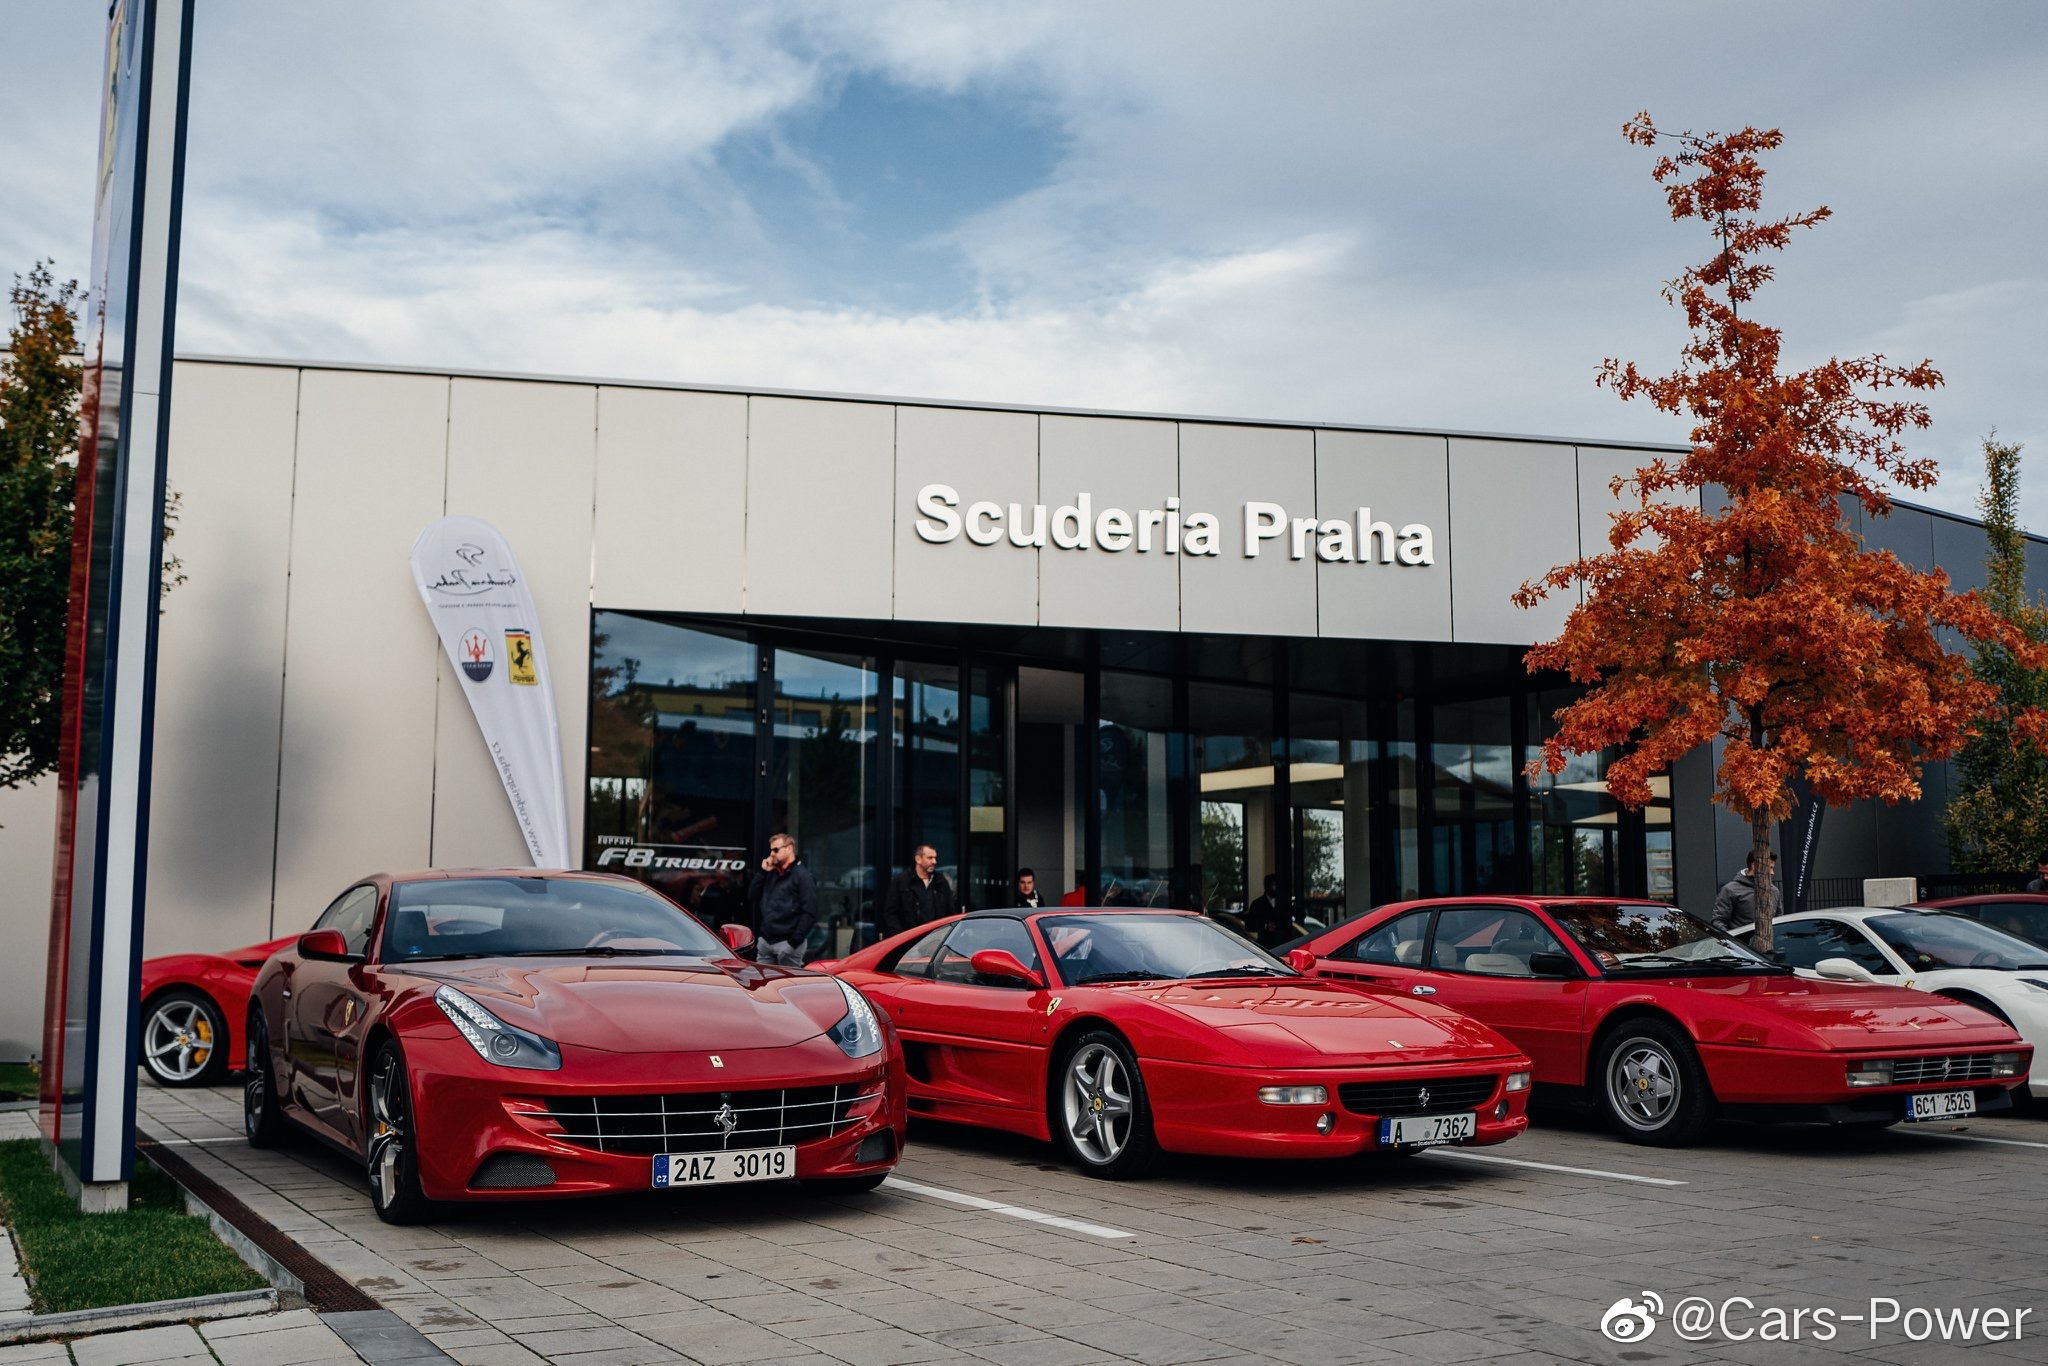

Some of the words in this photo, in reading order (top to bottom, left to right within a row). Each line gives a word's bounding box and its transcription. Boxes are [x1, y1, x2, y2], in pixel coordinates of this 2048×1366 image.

[915, 483, 1220, 555] Scuderia
[1243, 500, 1435, 566] Praha
[597, 835, 634, 846] Ferrari
[597, 847, 656, 868] F8
[654, 856, 746, 871] TRIBUTO
[1915, 1095, 1937, 1115] 6C1
[1944, 1092, 1971, 1113] 2526
[1395, 1121, 1402, 1142] A
[1433, 1116, 1469, 1139] 7362
[673, 1156, 716, 1182] 2AZ
[733, 1151, 786, 1178] 3019
[656, 1175, 668, 1183] CZ
